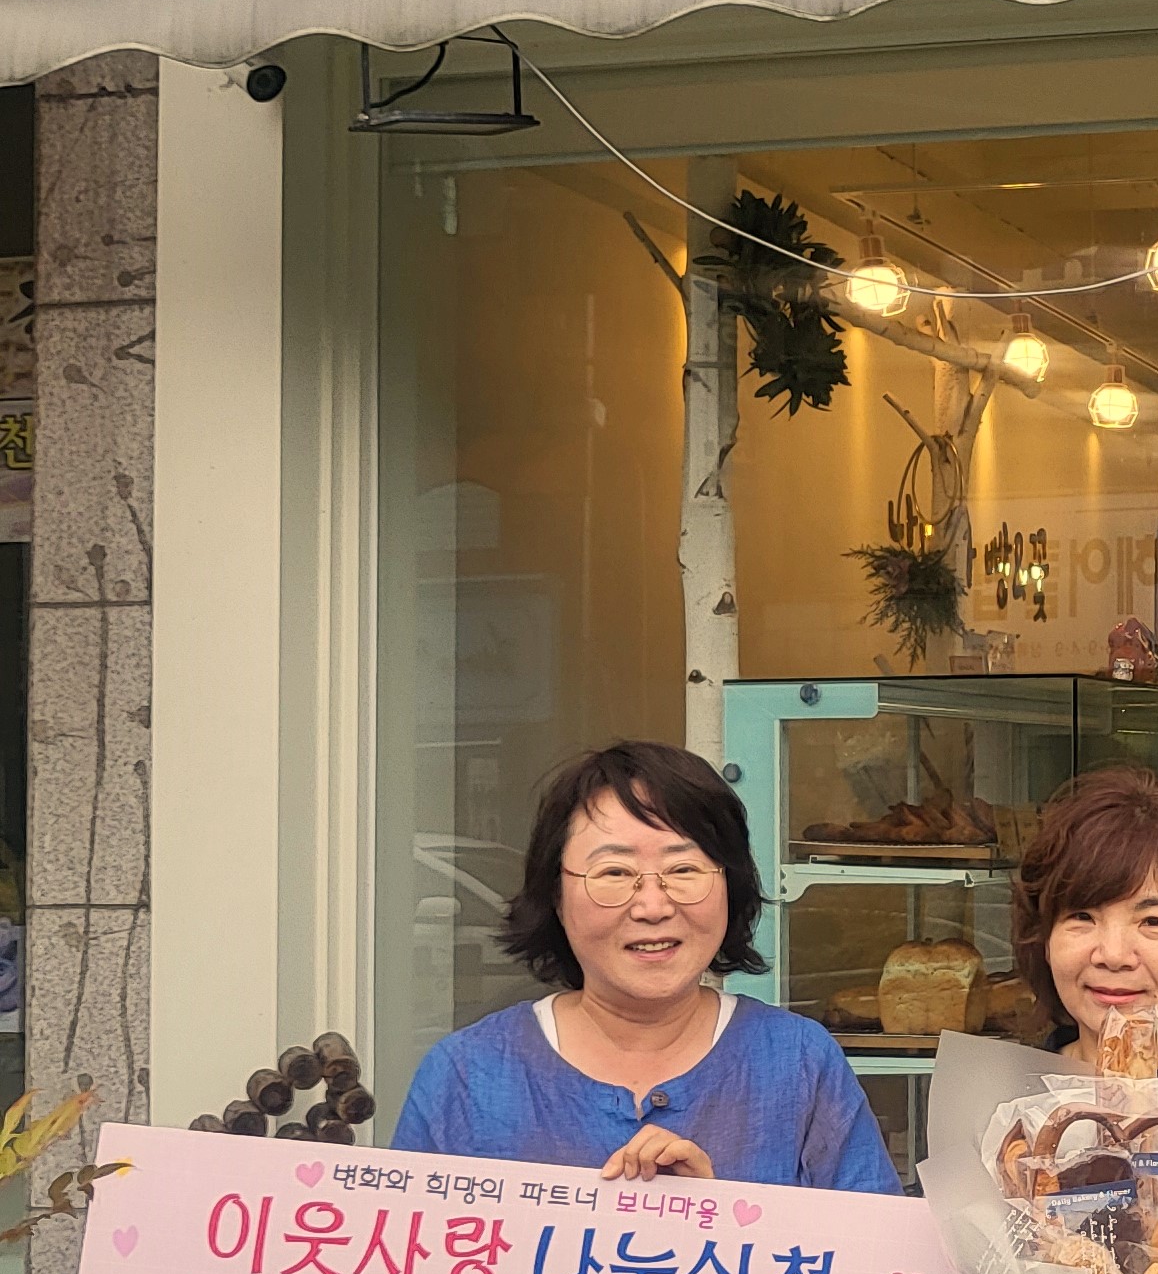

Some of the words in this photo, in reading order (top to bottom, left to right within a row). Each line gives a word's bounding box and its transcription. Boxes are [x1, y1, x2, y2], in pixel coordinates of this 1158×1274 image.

[332, 1163, 414, 1194] 변화와
[425, 1171, 503, 1204] 희망의
[519, 1180, 599, 1212] 파트너
[615, 1190, 720, 1229] 보니마을
